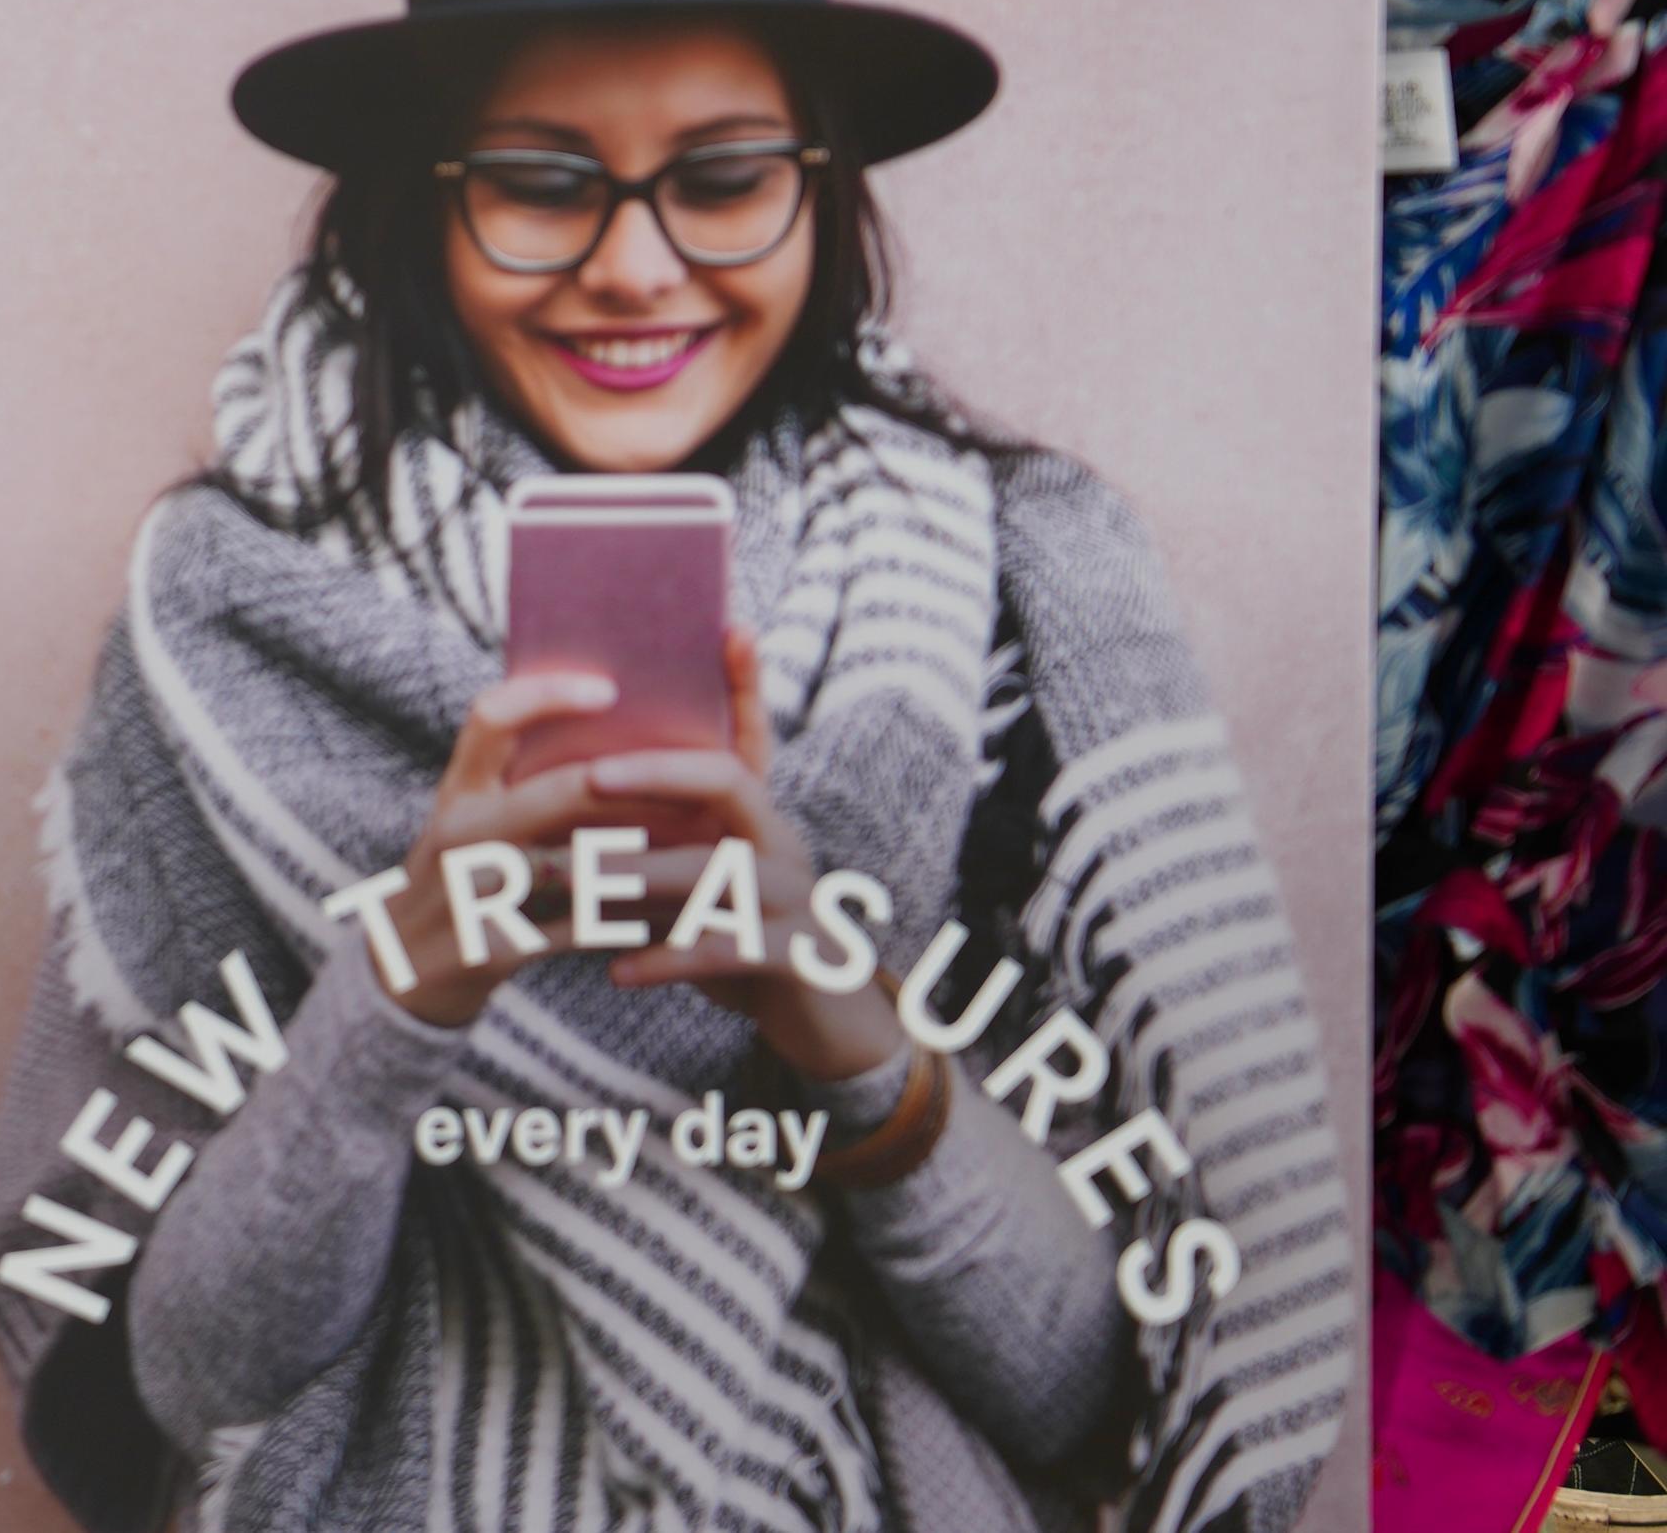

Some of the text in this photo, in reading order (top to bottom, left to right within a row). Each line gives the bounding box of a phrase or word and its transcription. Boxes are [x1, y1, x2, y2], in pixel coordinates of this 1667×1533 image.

[323, 826, 1241, 1327] TREASURES
[415, 1092, 829, 1189] every day
